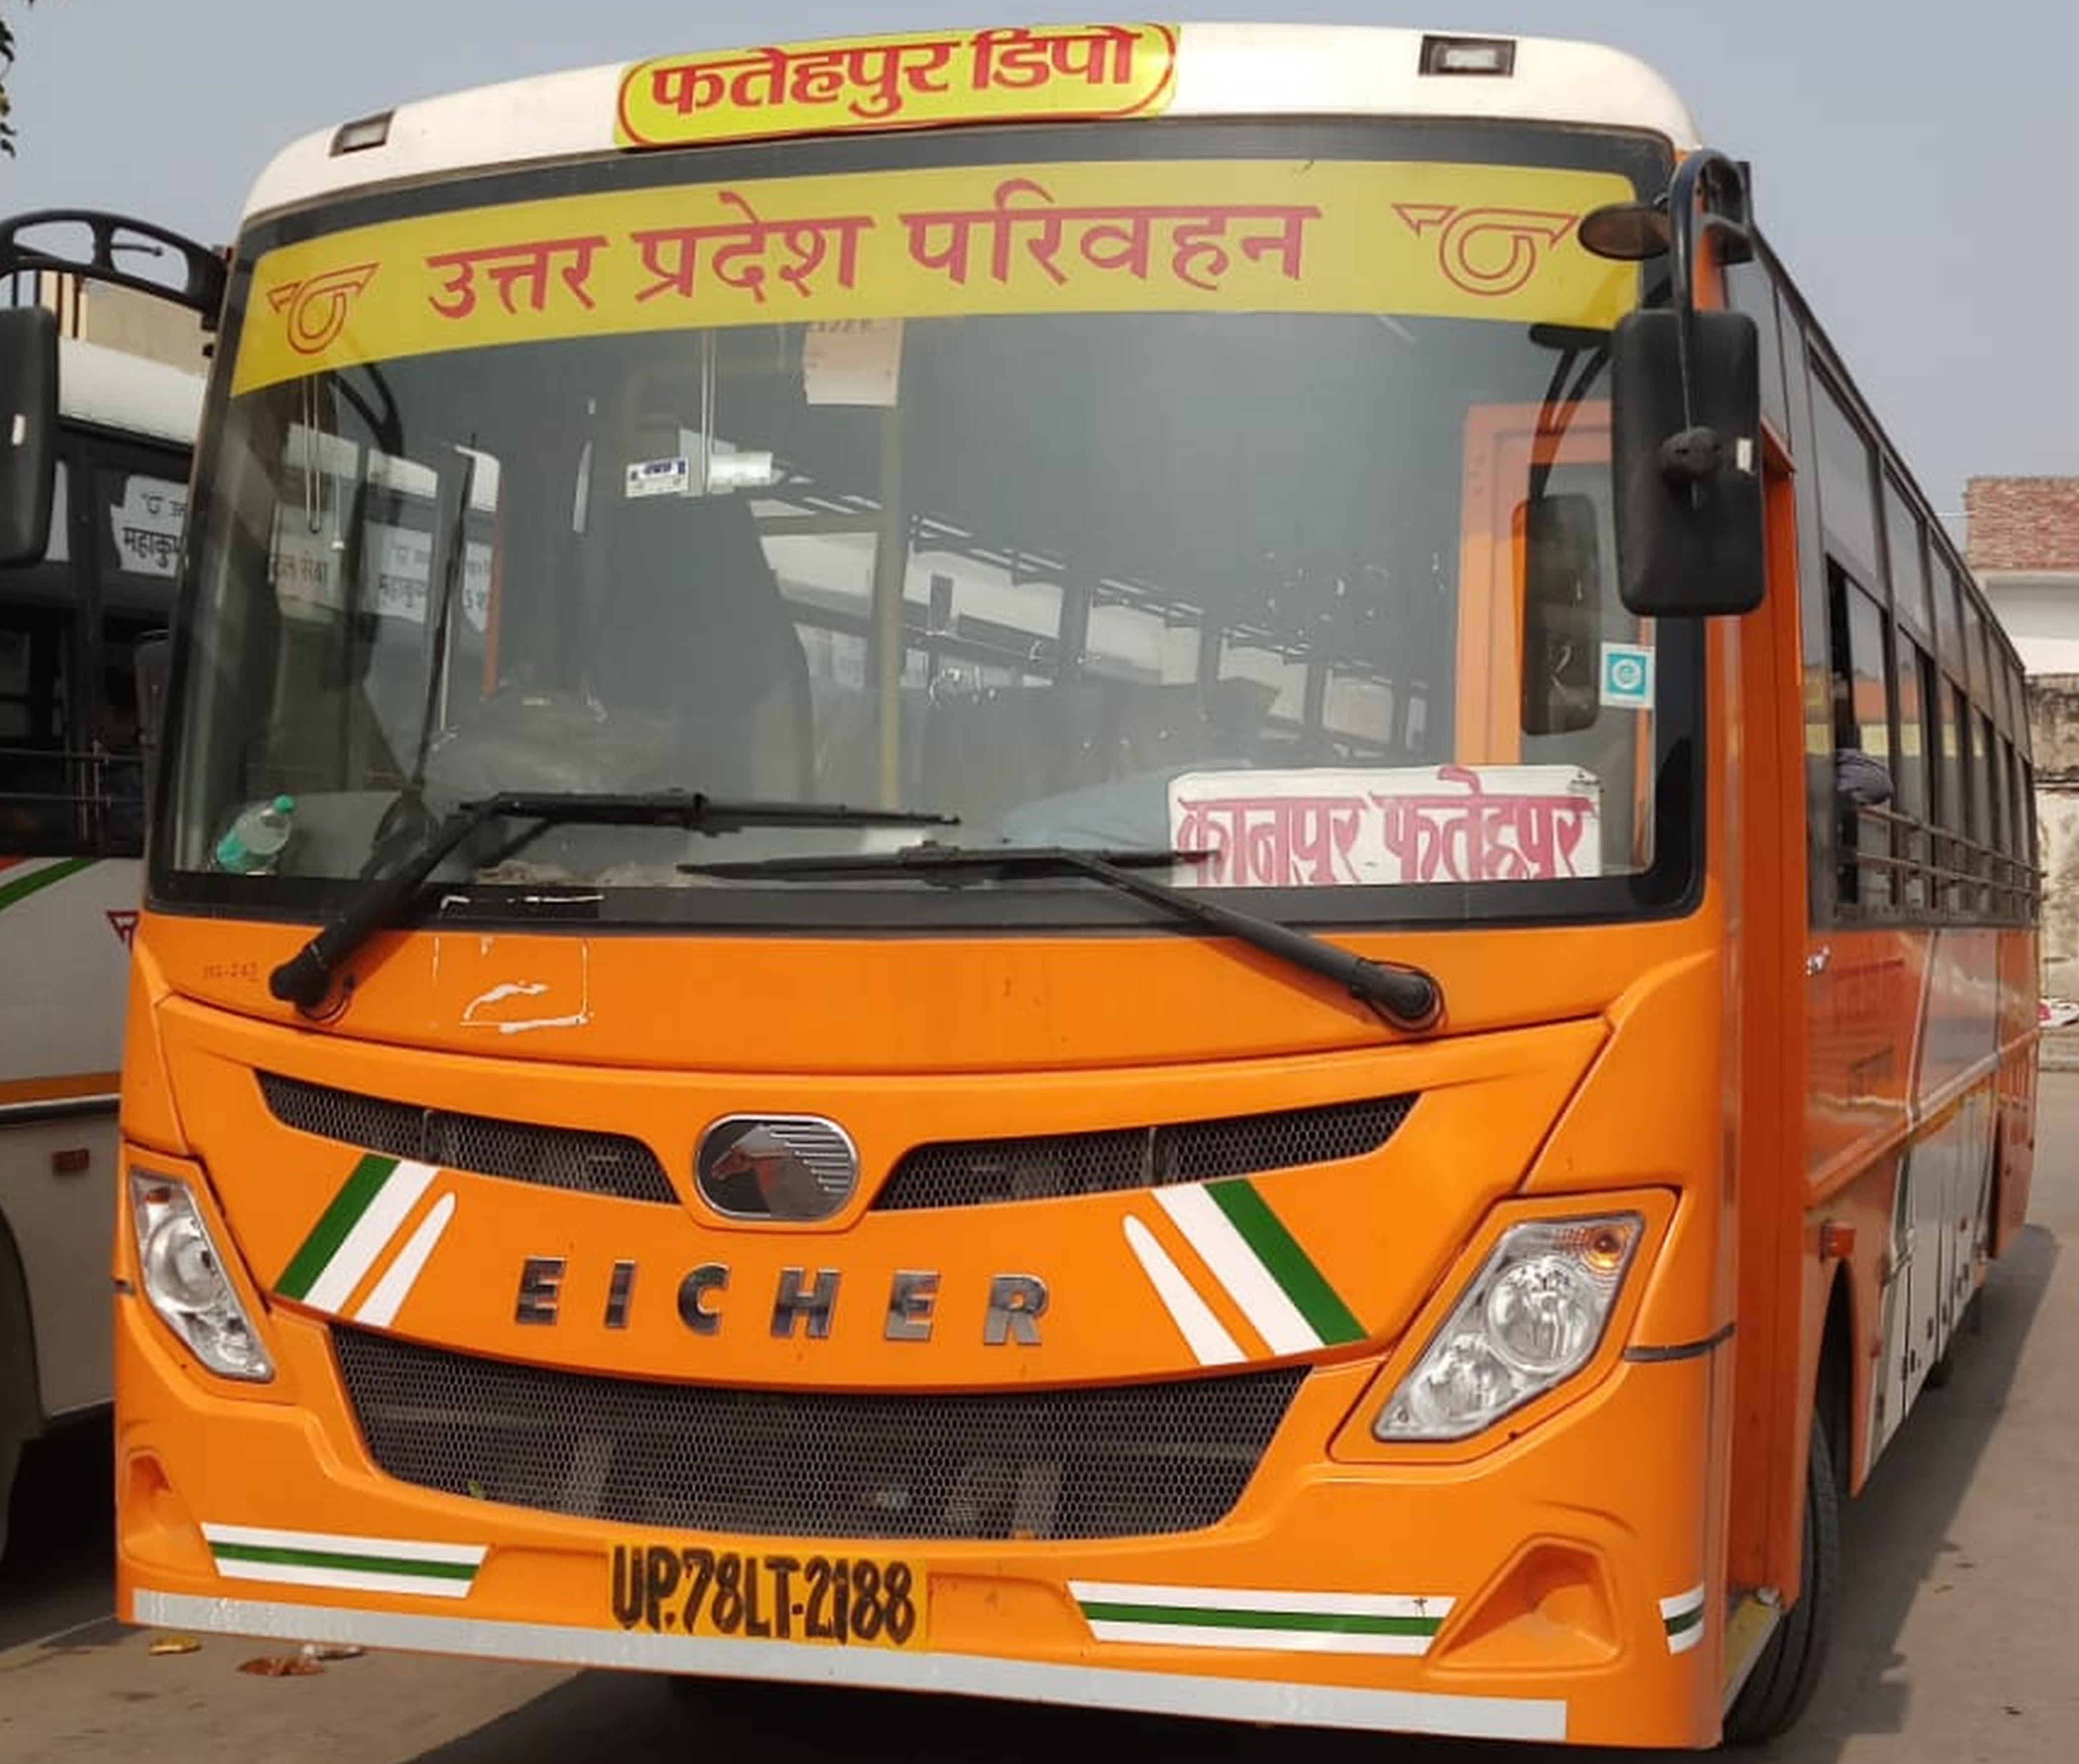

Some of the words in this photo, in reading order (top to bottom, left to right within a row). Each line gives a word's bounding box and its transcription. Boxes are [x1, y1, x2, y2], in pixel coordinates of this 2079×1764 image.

[652, 48, 962, 118] फतेहपुर
[969, 25, 1142, 88] डिपो
[425, 235, 609, 319] उत्तर
[630, 190, 876, 304] प्रदेश
[899, 178, 1323, 291] परिवहन
[514, 1256, 1050, 1346] EICHER
